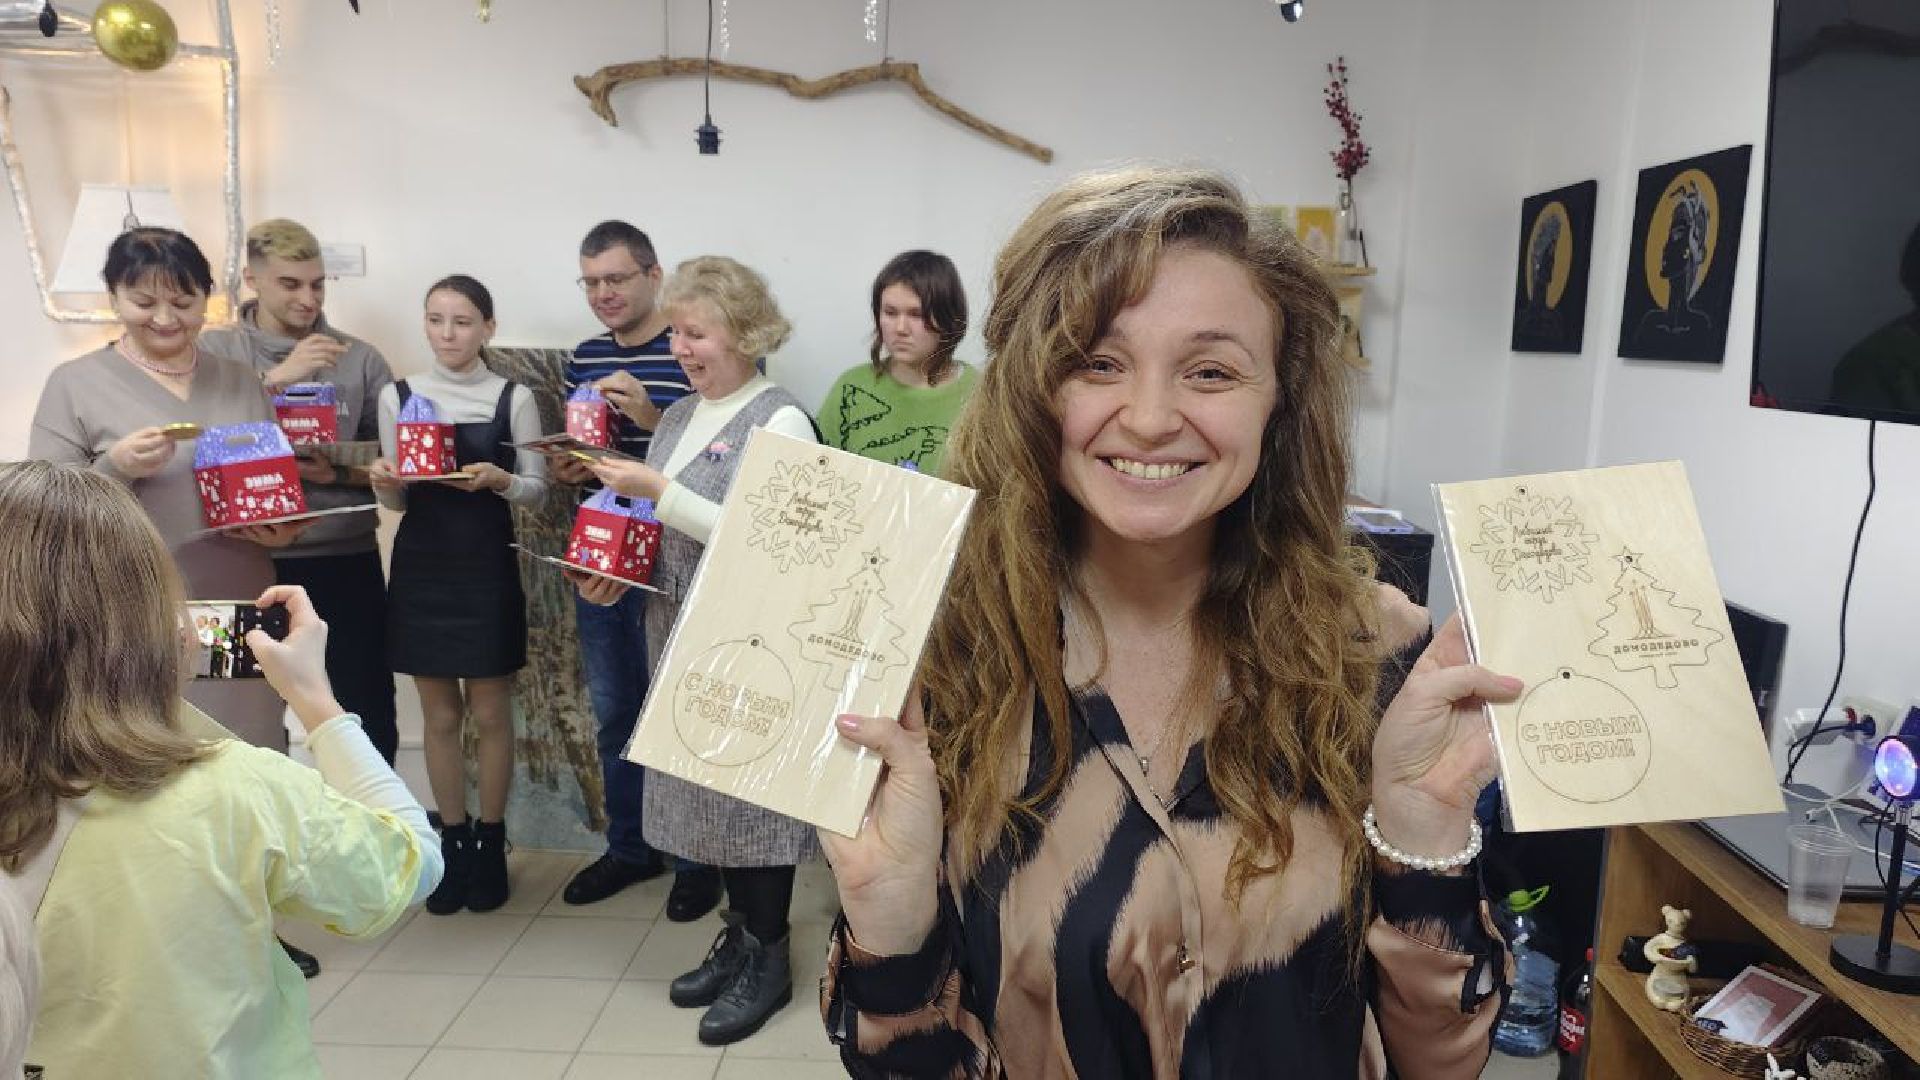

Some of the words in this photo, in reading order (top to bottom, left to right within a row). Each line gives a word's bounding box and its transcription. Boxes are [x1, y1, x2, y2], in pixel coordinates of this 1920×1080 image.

[282, 417, 320, 430] ЗИМА
[243, 472, 285, 489] ЗИМА
[807, 634, 885, 662] ДОМОДЕДОВО
[1613, 639, 1699, 655] ДОМОДЕДОВО
[685, 673, 703, 691] С
[703, 678, 791, 719] НОВЫМ
[1521, 723, 1540, 742] С
[1543, 715, 1642, 741] НОВЫМ
[1536, 738, 1636, 764] ГОДОМ!
